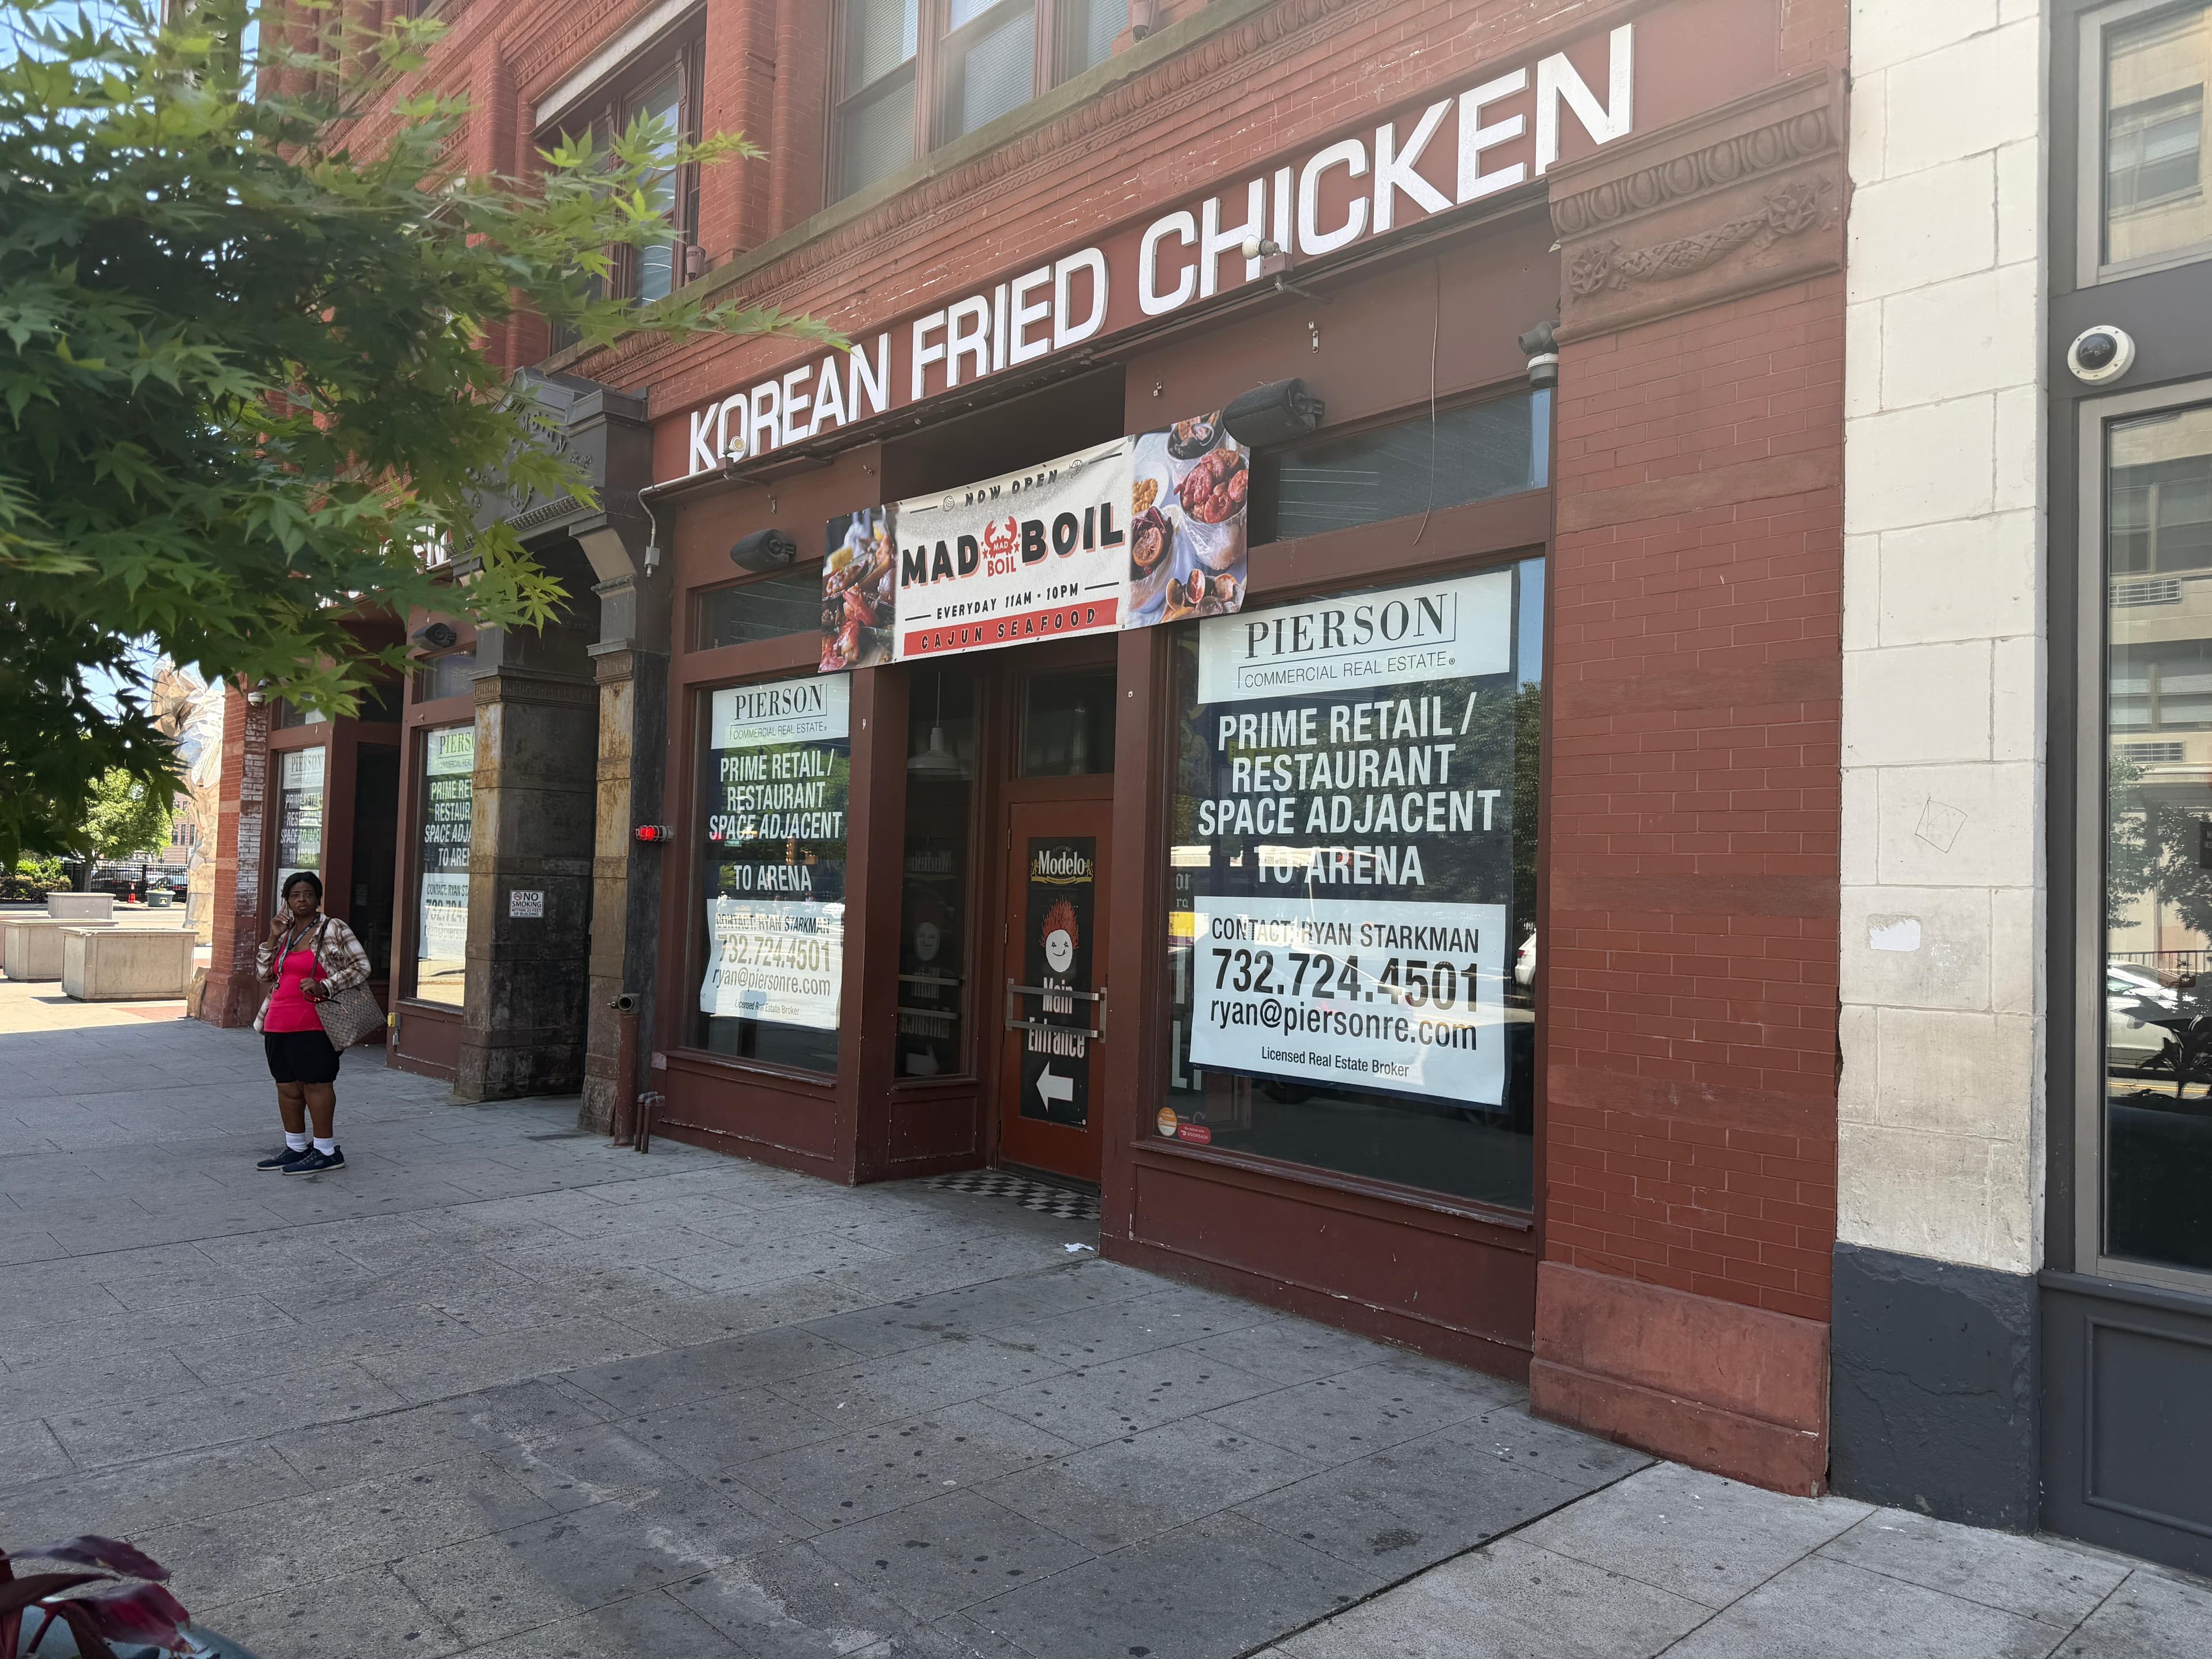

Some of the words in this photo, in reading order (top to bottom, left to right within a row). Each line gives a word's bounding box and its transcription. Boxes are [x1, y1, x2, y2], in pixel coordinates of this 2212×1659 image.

[690, 332, 891, 475] KOREAN
[912, 248, 1109, 401] FRIED
[1138, 23, 1634, 316] CHICKEN
[965, 485, 1001, 507] NOW
[1012, 469, 1058, 494] OPEN
[901, 534, 980, 590] MAD
[1021, 502, 1126, 567] BOIL
[993, 541, 1009, 551] MAD
[987, 556, 1017, 577] BOIL
[936, 598, 997, 620] EVERYDAY
[1005, 591, 1032, 608] 11AM
[1046, 583, 1079, 600] 10PM
[921, 627, 983, 650] CAJUN
[997, 608, 1096, 639] SEAFOOD
[1244, 594, 1448, 659] PIERSON
[1245, 665, 1338, 688] COMMERCIAL
[1343, 660, 1382, 677] REAL
[734, 684, 824, 720] PIERSON
[439, 732, 475, 754] PIERS
[733, 726, 776, 740] COMMERCIAL
[778, 724, 795, 736] REAL
[1218, 708, 1317, 752] PRIME
[720, 754, 767, 782] PRIME
[1232, 744, 1456, 794] RESTAURANT
[430, 779, 456, 800] PRIME
[726, 781, 826, 812] RESTAURANT
[434, 801, 472, 822] RESTAUR
[709, 814, 757, 840] SPACE
[758, 811, 843, 840] ADJACENT
[1198, 796, 1296, 836] SPACE
[1305, 789, 1501, 834] ADJACENT
[280, 828, 298, 844] SPACE
[424, 823, 451, 843] SPACE
[289, 847, 296, 863] TO
[438, 847, 449, 867] TO
[1038, 850, 1085, 876] Modelo
[1254, 846, 1294, 883] TO
[1304, 845, 1425, 886] ARENA
[733, 865, 752, 890] TO
[756, 865, 812, 891] ARENA
[524, 892, 539, 902] NO
[716, 914, 756, 930] CONTACT:
[759, 915, 782, 931] RYAN
[785, 916, 830, 934] STARKMAN
[1211, 917, 1294, 943] CONTACT:
[1301, 921, 1352, 946] RYAN
[1360, 923, 1479, 953] STARKMAN
[718, 934, 830, 972] 732.724.4501
[712, 967, 831, 997] ryan@piersonre.com
[1042, 976, 1073, 1014] Main
[1211, 948, 1478, 1013] 732.724.4501
[734, 999, 755, 1010] Licensed
[765, 1003, 781, 1014] Estate
[781, 1005, 800, 1016] Broker
[1028, 1016, 1085, 1059] Entrance
[1210, 997, 1477, 1051] ryan@piersonre.com
[1262, 1046, 1305, 1065] Licensed
[1309, 1052, 1331, 1067] Real
[1335, 1055, 1368, 1072] Estate
[1372, 1059, 1409, 1077] Broker
